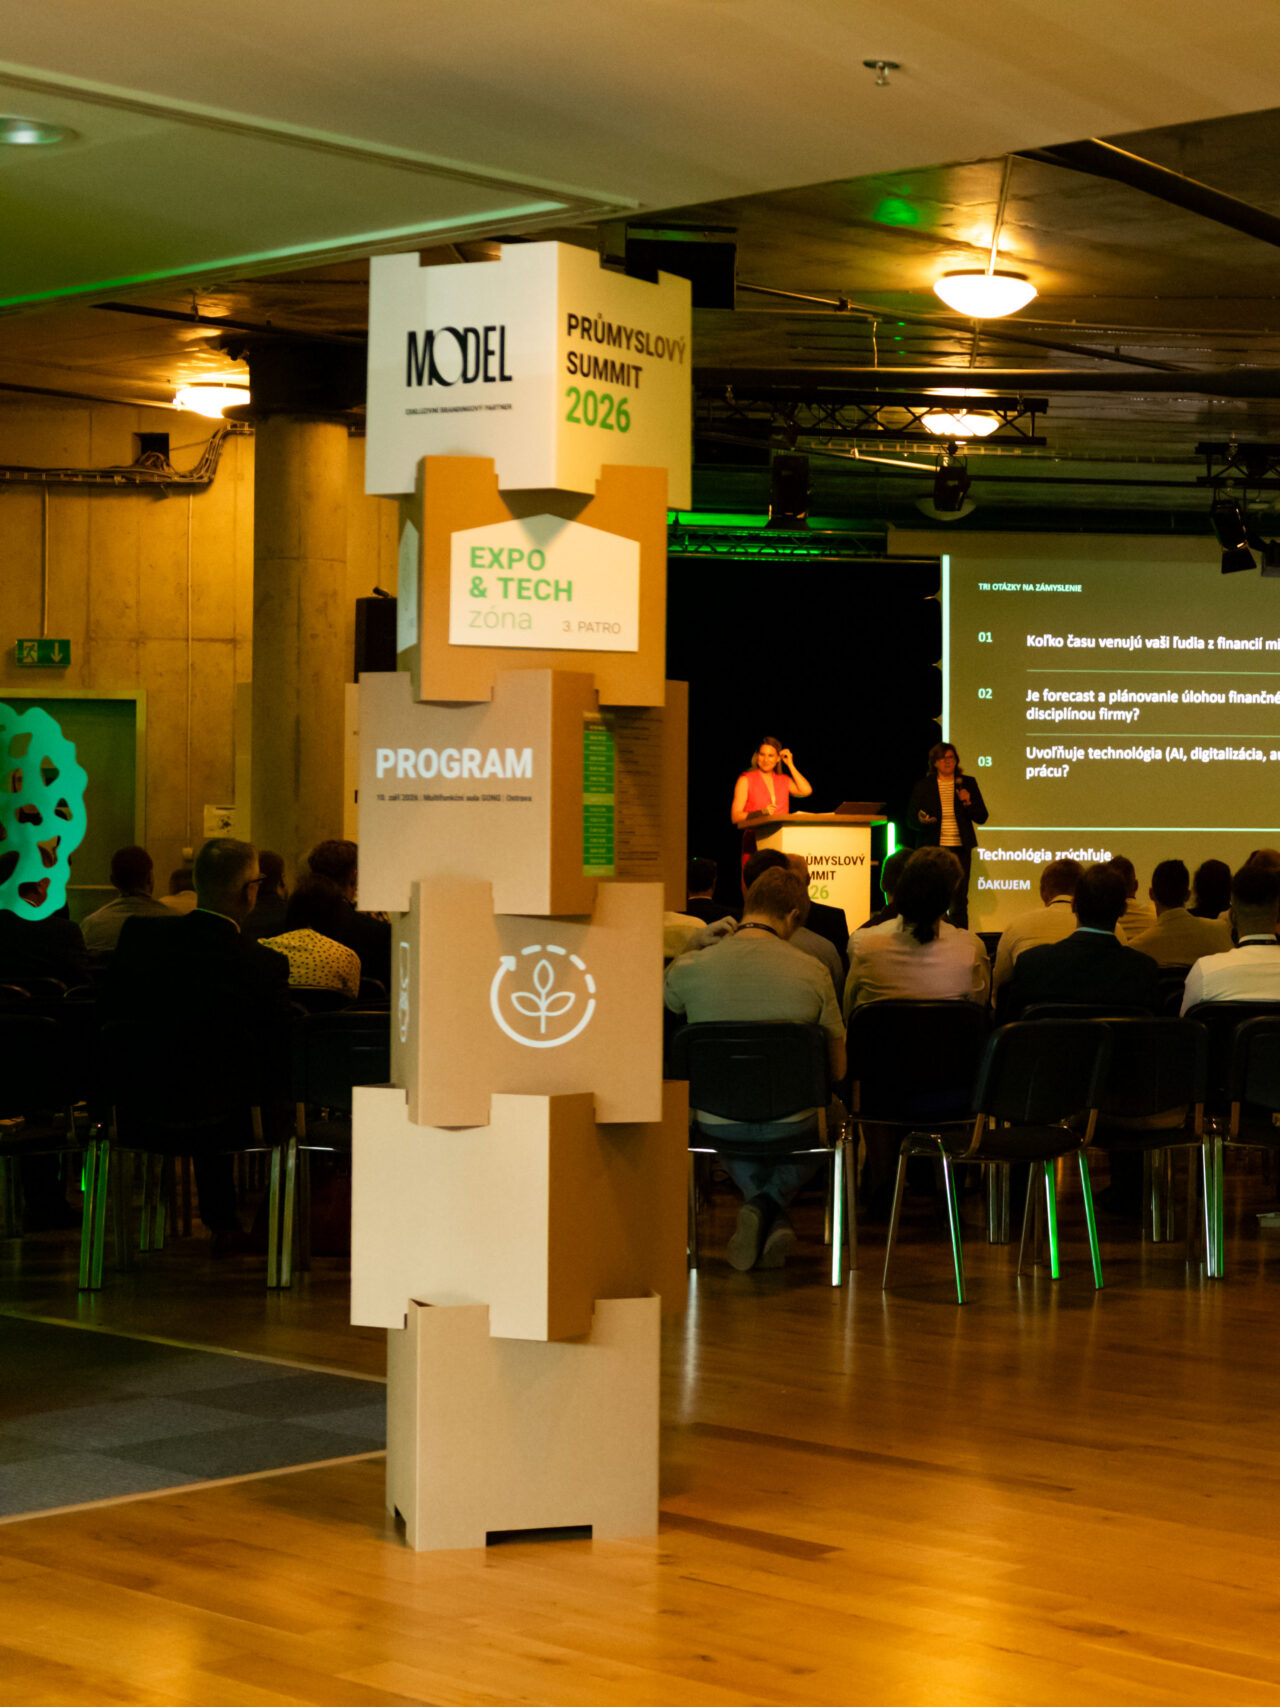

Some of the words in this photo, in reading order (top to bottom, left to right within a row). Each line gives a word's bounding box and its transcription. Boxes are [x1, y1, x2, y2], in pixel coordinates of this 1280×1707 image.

[567, 313, 685, 365] PRŮMYSLOVÝ
[406, 325, 512, 387] MODEL
[567, 351, 643, 389] SUMMIT
[566, 386, 631, 433] 2026
[470, 547, 547, 571] EXPO
[469, 576, 487, 598] &
[497, 577, 573, 602] TECH
[978, 582, 990, 591] TRI
[992, 581, 1021, 592] OTÁZKY
[1022, 583, 1034, 592] NA
[1035, 582, 1082, 593] ZÁMYSLENIE
[469, 605, 533, 630] zóna
[562, 620, 573, 633] 3.
[577, 620, 622, 635] PATRO
[978, 632, 993, 643] 01
[1026, 634, 1064, 648] Koľko
[1066, 635, 1095, 648] času
[1099, 636, 1142, 651] venujú
[1145, 636, 1170, 649] vaši
[1173, 636, 1205, 649] ľudia
[1208, 639, 1214, 649] z
[1217, 637, 1263, 650] financií
[978, 688, 993, 699] 02
[1026, 689, 1040, 702] Je
[1043, 689, 1095, 702] forecast
[1098, 692, 1106, 702] a
[1109, 690, 1179, 705] plánovanie
[1181, 690, 1226, 703] úlohou
[1026, 707, 1096, 723] disciplínou
[1099, 708, 1140, 723] firmy?
[978, 756, 992, 767] 03
[1026, 746, 1085, 762] Uvoľňuje
[1088, 746, 1162, 762] technológia
[1165, 747, 1187, 763] (AI,
[1190, 747, 1267, 763] digitalizácia,
[376, 748, 533, 779] PROGRAM
[1026, 765, 1070, 780] prácu?
[805, 852, 865, 866] ŮMYSLOVÝ
[977, 848, 1052, 864] Technológia
[809, 870, 836, 881] MMIT
[977, 877, 1031, 890] ĎAKUJEM
[809, 884, 829, 900] 26
